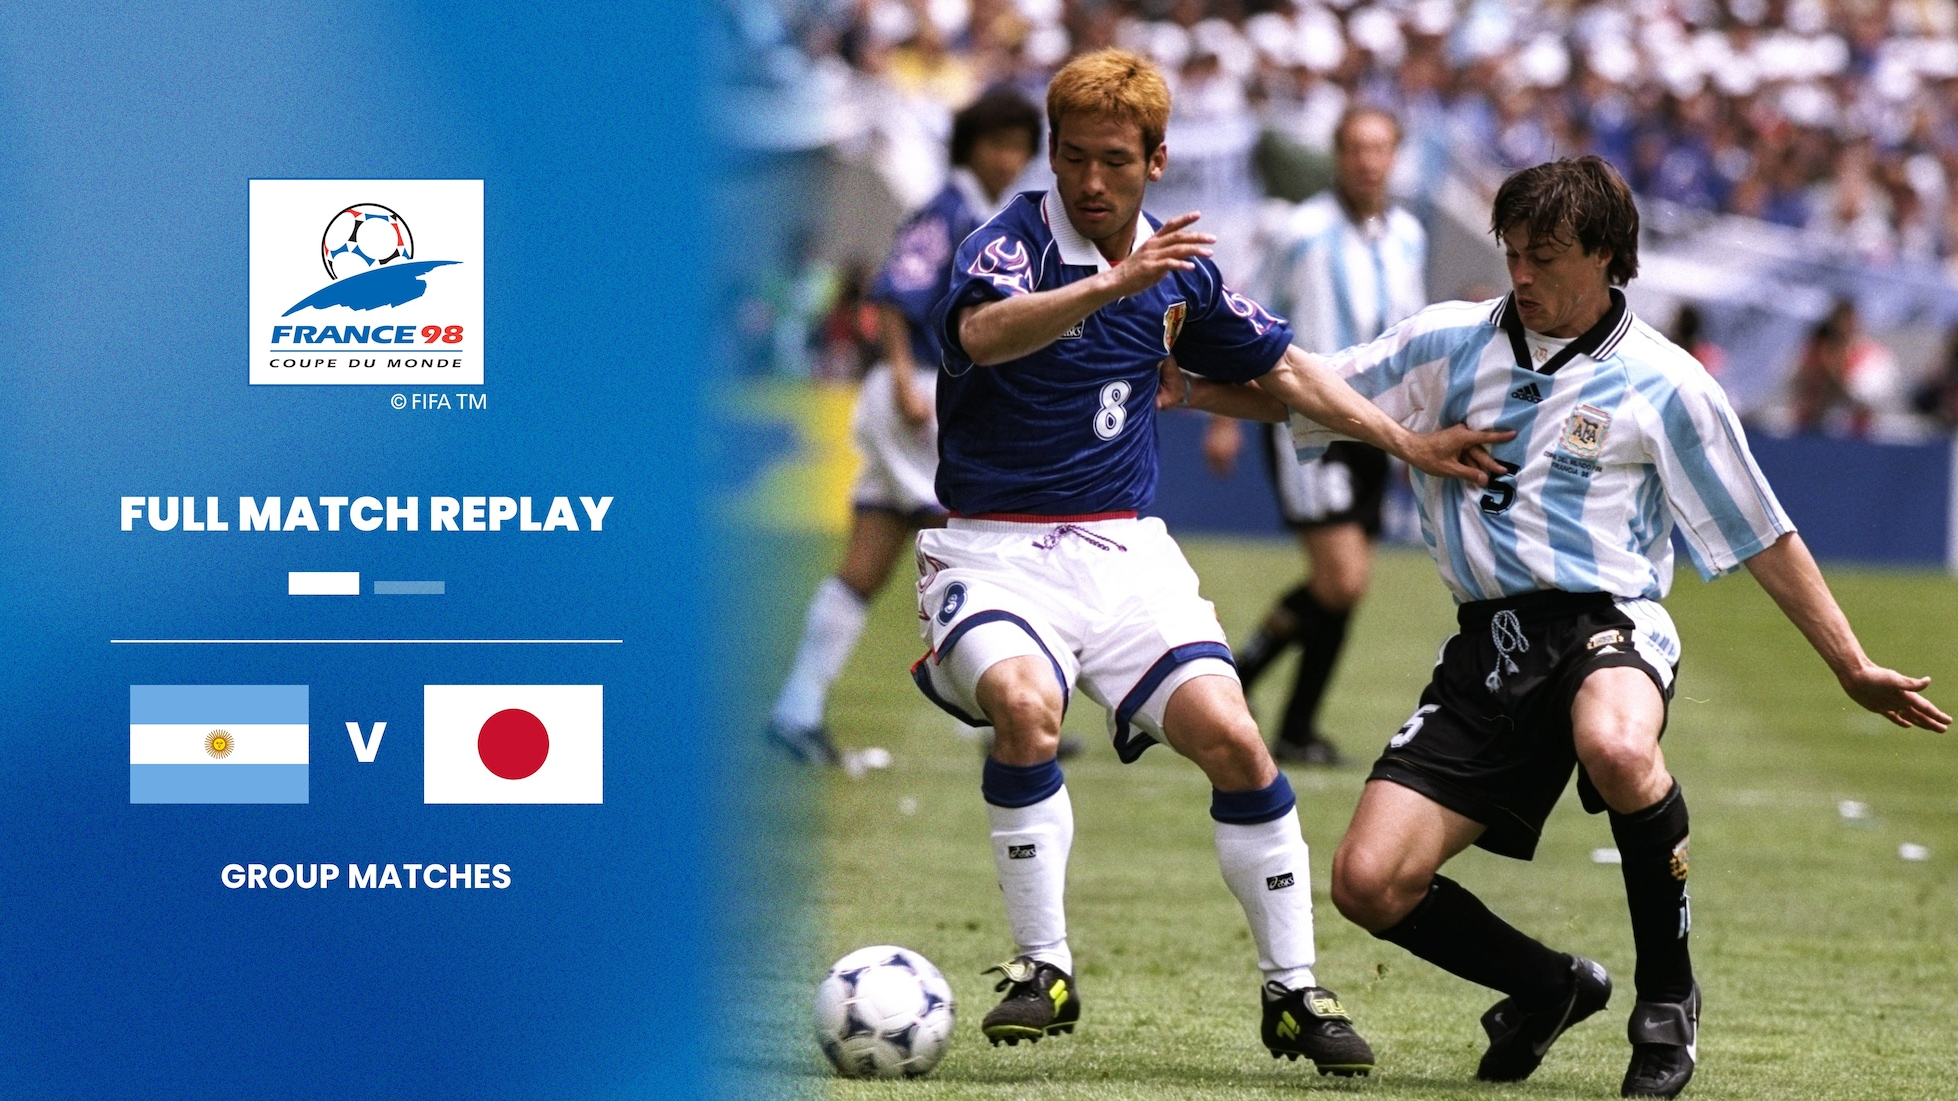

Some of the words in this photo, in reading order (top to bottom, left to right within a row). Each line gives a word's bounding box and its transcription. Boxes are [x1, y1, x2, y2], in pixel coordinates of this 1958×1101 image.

[1093, 380, 1132, 441] 8
[1480, 459, 1521, 515] 5
[1391, 704, 1441, 748] 5
